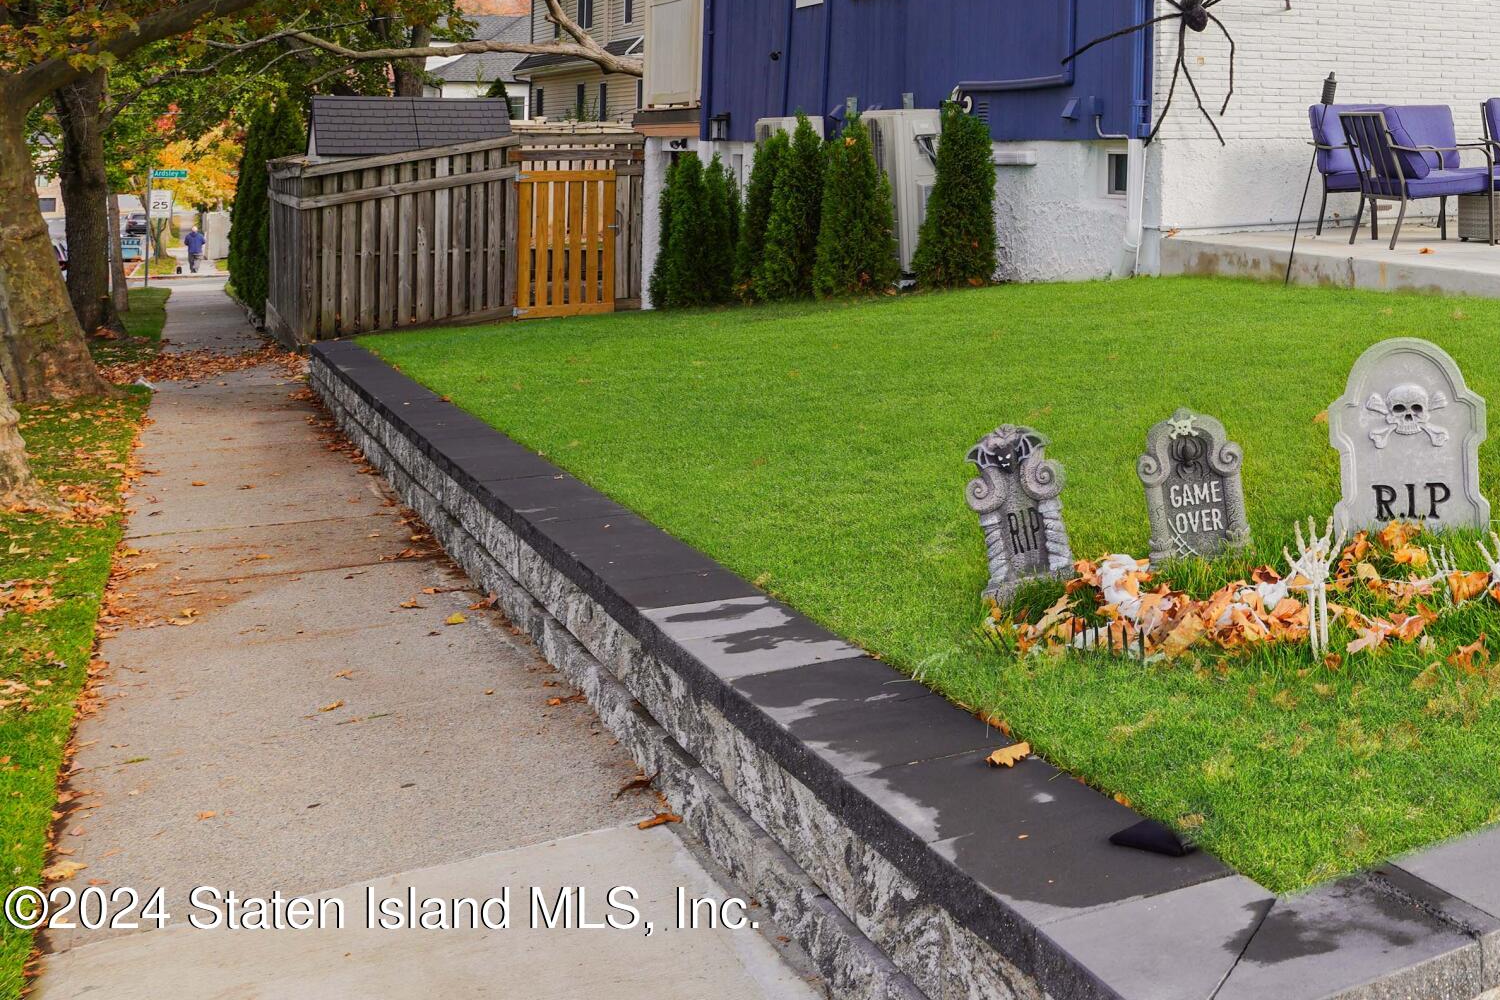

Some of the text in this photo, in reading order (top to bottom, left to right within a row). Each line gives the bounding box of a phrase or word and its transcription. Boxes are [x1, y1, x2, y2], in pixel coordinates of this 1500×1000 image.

[154, 170, 179, 178] Ardsley
[152, 201, 168, 210] 25
[1170, 480, 1222, 508] GAME
[1007, 506, 1041, 555] RIP
[1175, 508, 1224, 534] OVER
